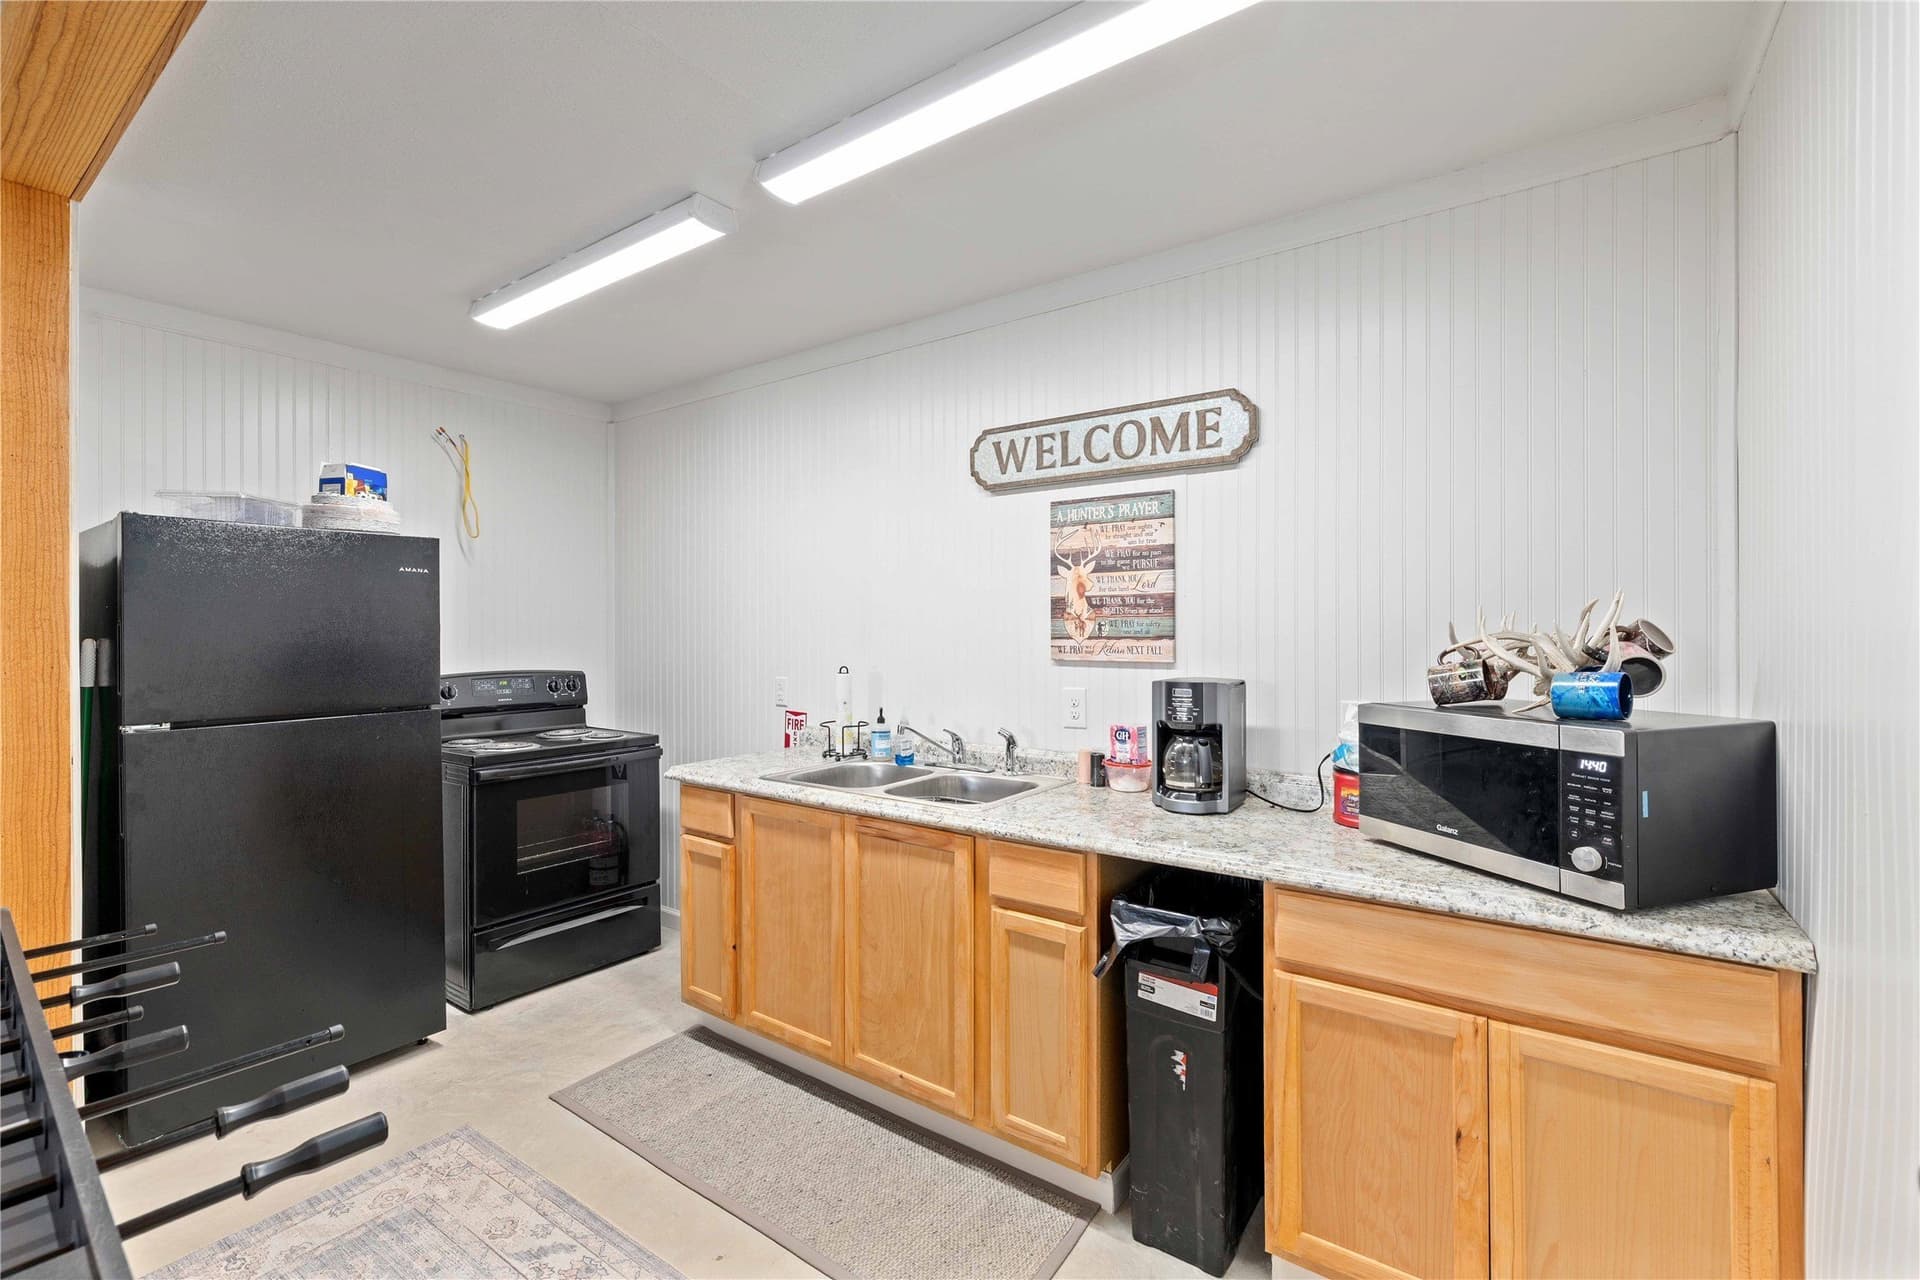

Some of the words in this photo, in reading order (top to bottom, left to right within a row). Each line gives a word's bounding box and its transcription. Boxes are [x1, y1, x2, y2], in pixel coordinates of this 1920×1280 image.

[992, 406, 1223, 475] WELCOME
[1057, 512, 1064, 523] A
[1119, 501, 1160, 517] PRAYER
[1112, 524, 1125, 532] PRAY
[1117, 549, 1131, 558] PRAY
[1133, 559, 1160, 569] PURSUE
[1107, 574, 1127, 583] THANK
[1131, 573, 1161, 592] Lord
[1103, 596, 1123, 605] THANK
[1125, 596, 1136, 605] YOU
[1121, 619, 1135, 629] PRAY
[1058, 645, 1069, 654] WE
[1070, 645, 1084, 654] PRAY
[1095, 641, 1125, 656] Return
[1127, 645, 1144, 655] NEXT
[1147, 645, 1163, 655] FALL
[787, 717, 804, 731] FIRE
[1580, 759, 1607, 773] 1440
[1436, 823, 1458, 836] Galanz
